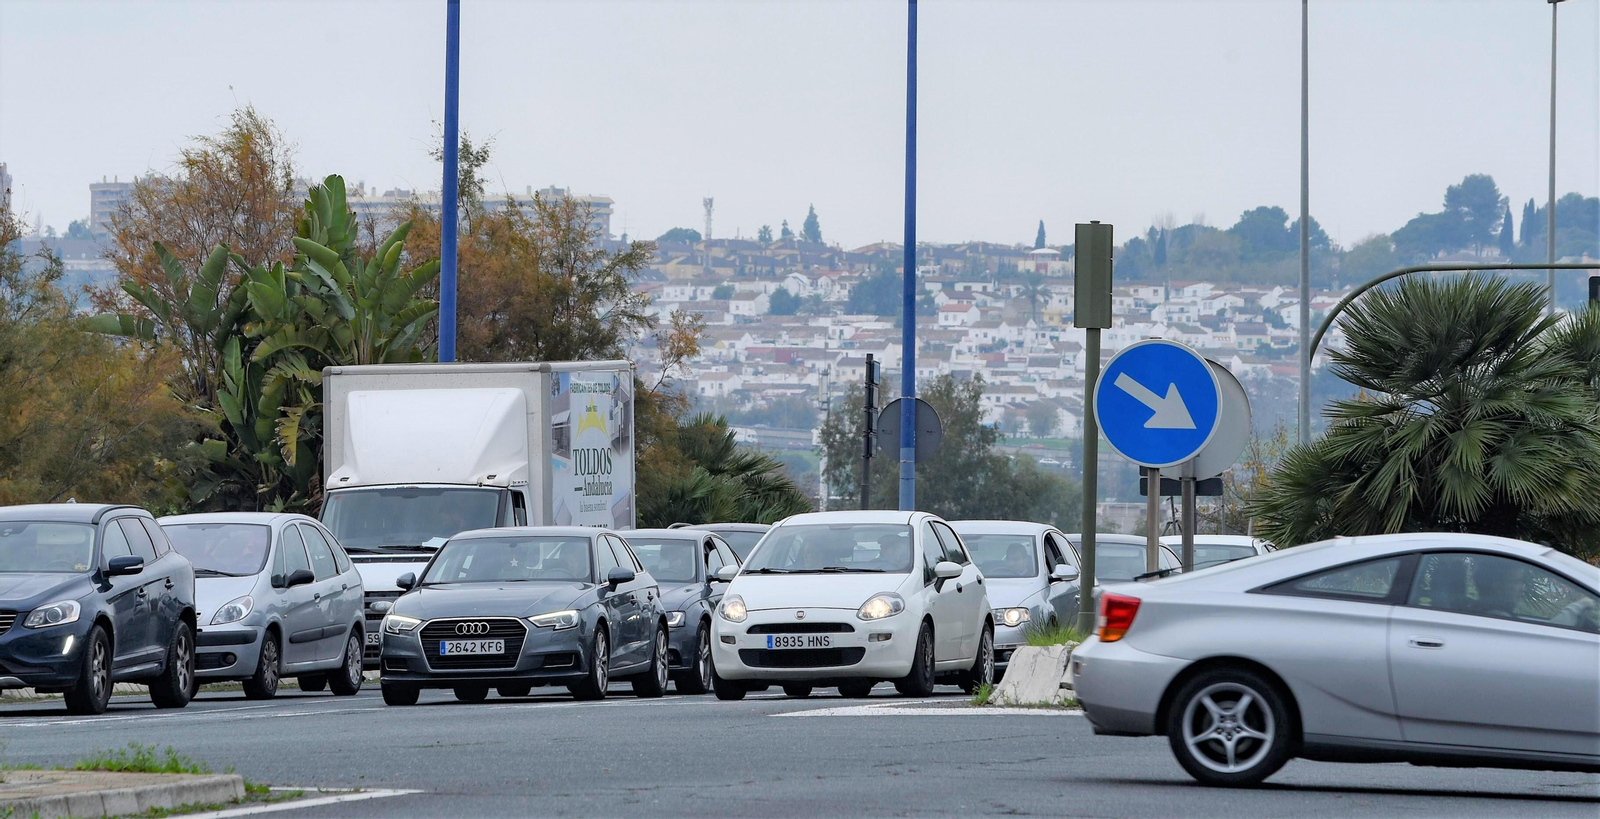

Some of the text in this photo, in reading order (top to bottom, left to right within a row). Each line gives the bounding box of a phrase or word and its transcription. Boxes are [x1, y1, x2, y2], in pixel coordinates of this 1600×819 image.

[592, 383, 598, 393] DE
[573, 447, 613, 476] TOLDOS
[367, 633, 379, 643] 59
[774, 635, 830, 647] 8935 HNS
[448, 641, 502, 653] 2642 KFG
